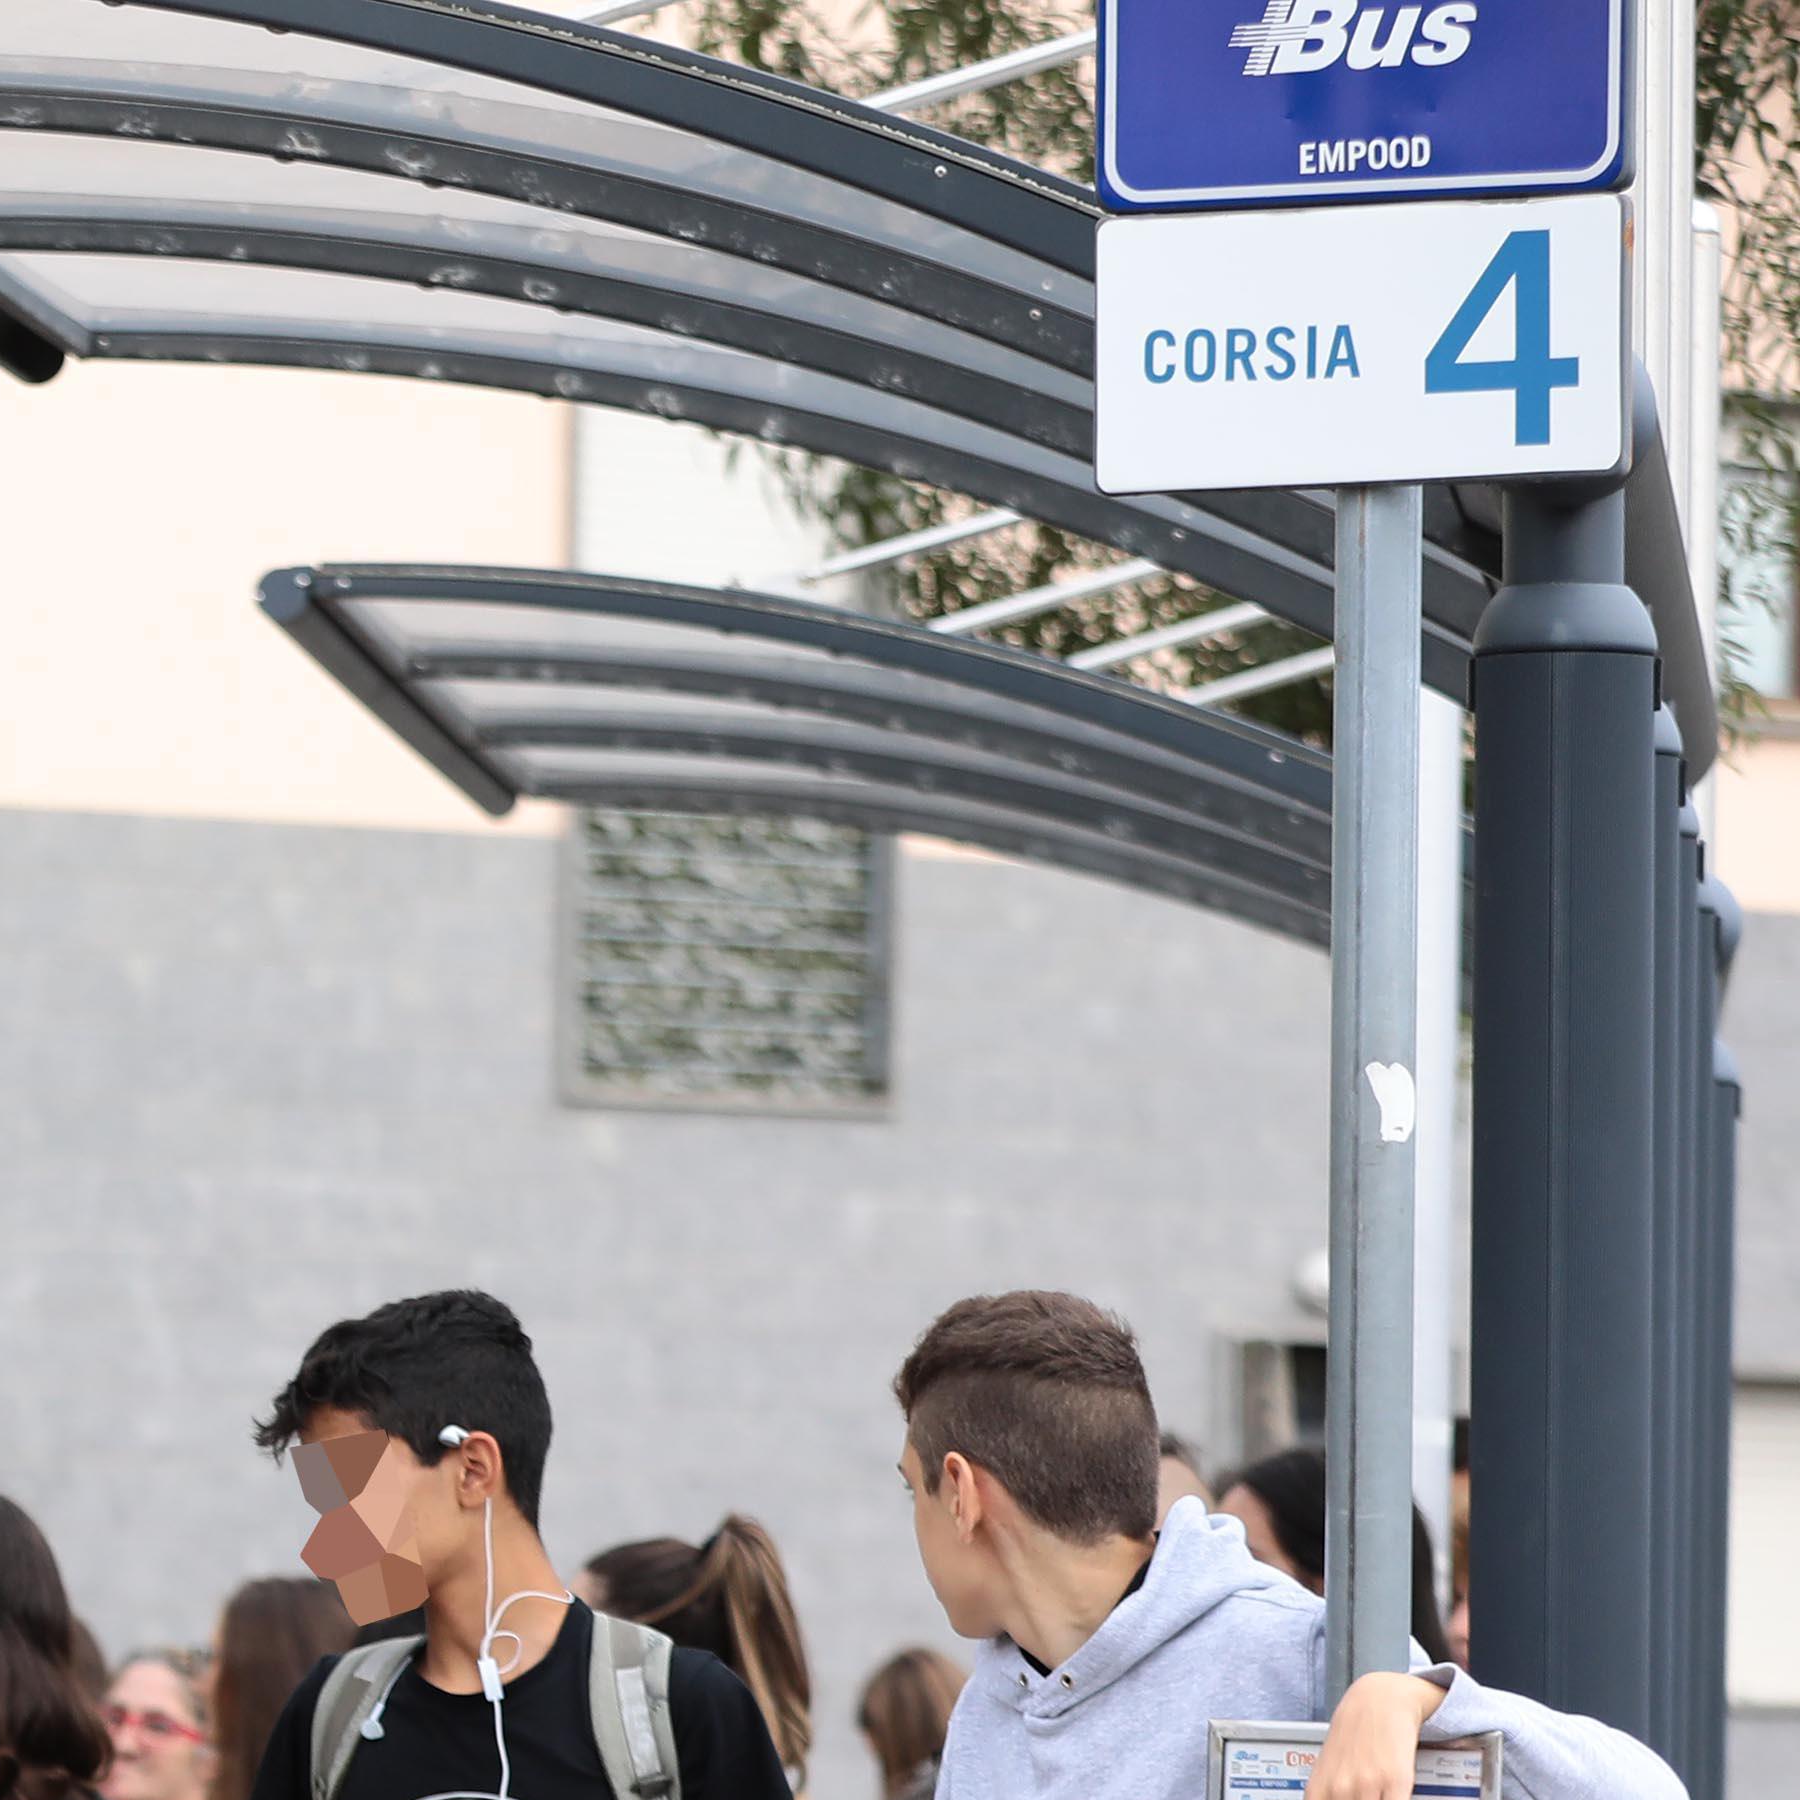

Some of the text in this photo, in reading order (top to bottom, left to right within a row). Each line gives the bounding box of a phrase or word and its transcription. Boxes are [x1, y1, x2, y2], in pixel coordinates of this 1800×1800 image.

[1299, 134, 1432, 175] EMPOOD
[1143, 228, 1580, 447] CORSIA 4
